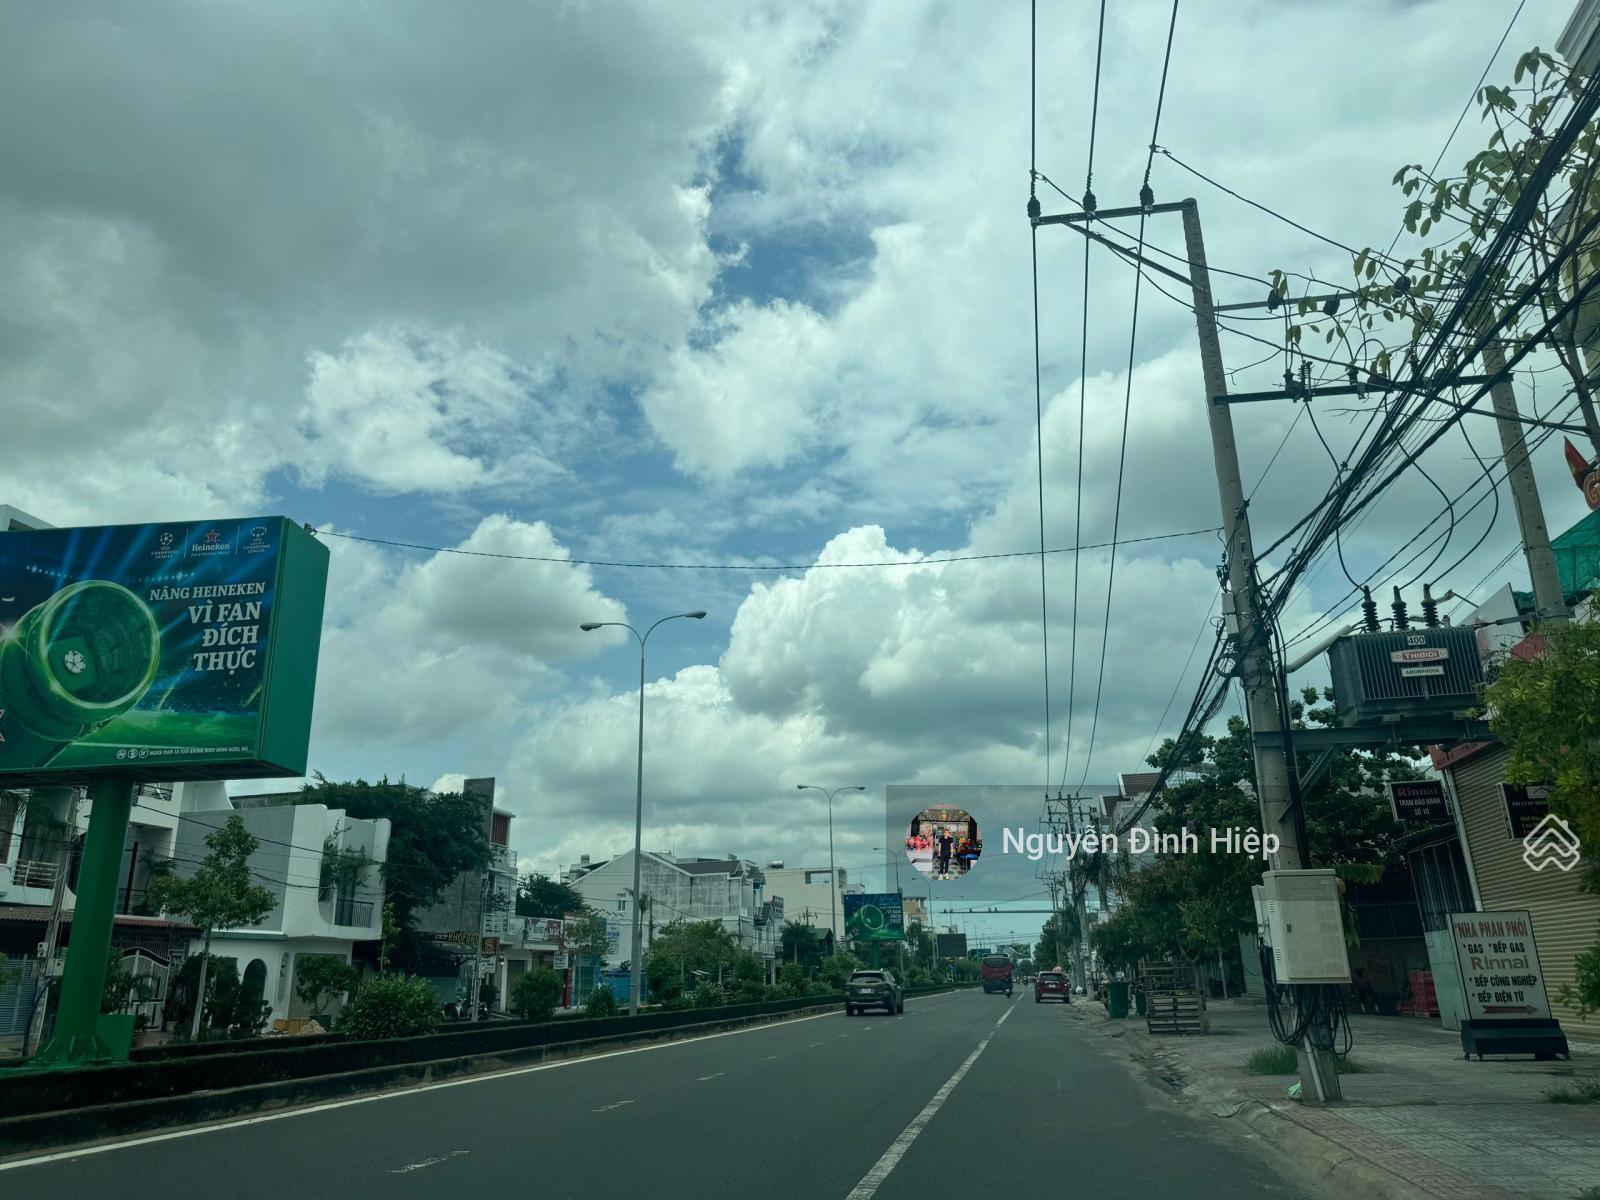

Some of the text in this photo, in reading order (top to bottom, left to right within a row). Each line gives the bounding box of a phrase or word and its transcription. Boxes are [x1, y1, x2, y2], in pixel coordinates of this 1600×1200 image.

[192, 543, 230, 552] Heineken
[149, 582, 266, 601] NÂNG HEINEKEN
[188, 599, 263, 624] VÌ FAN
[202, 622, 260, 647] ĐÍCH
[1408, 636, 1425, 644] 400
[193, 646, 257, 676] THỰC
[1404, 651, 1437, 660] THIBIDI
[1457, 919, 1479, 938] NHÀ
[1467, 940, 1526, 954] GAS BẾP GAS
[1470, 955, 1530, 970] Rinnai
[1474, 973, 1538, 989] BẾP CÔNG NGHIỆP
[1477, 989, 1492, 1003] BẾP
